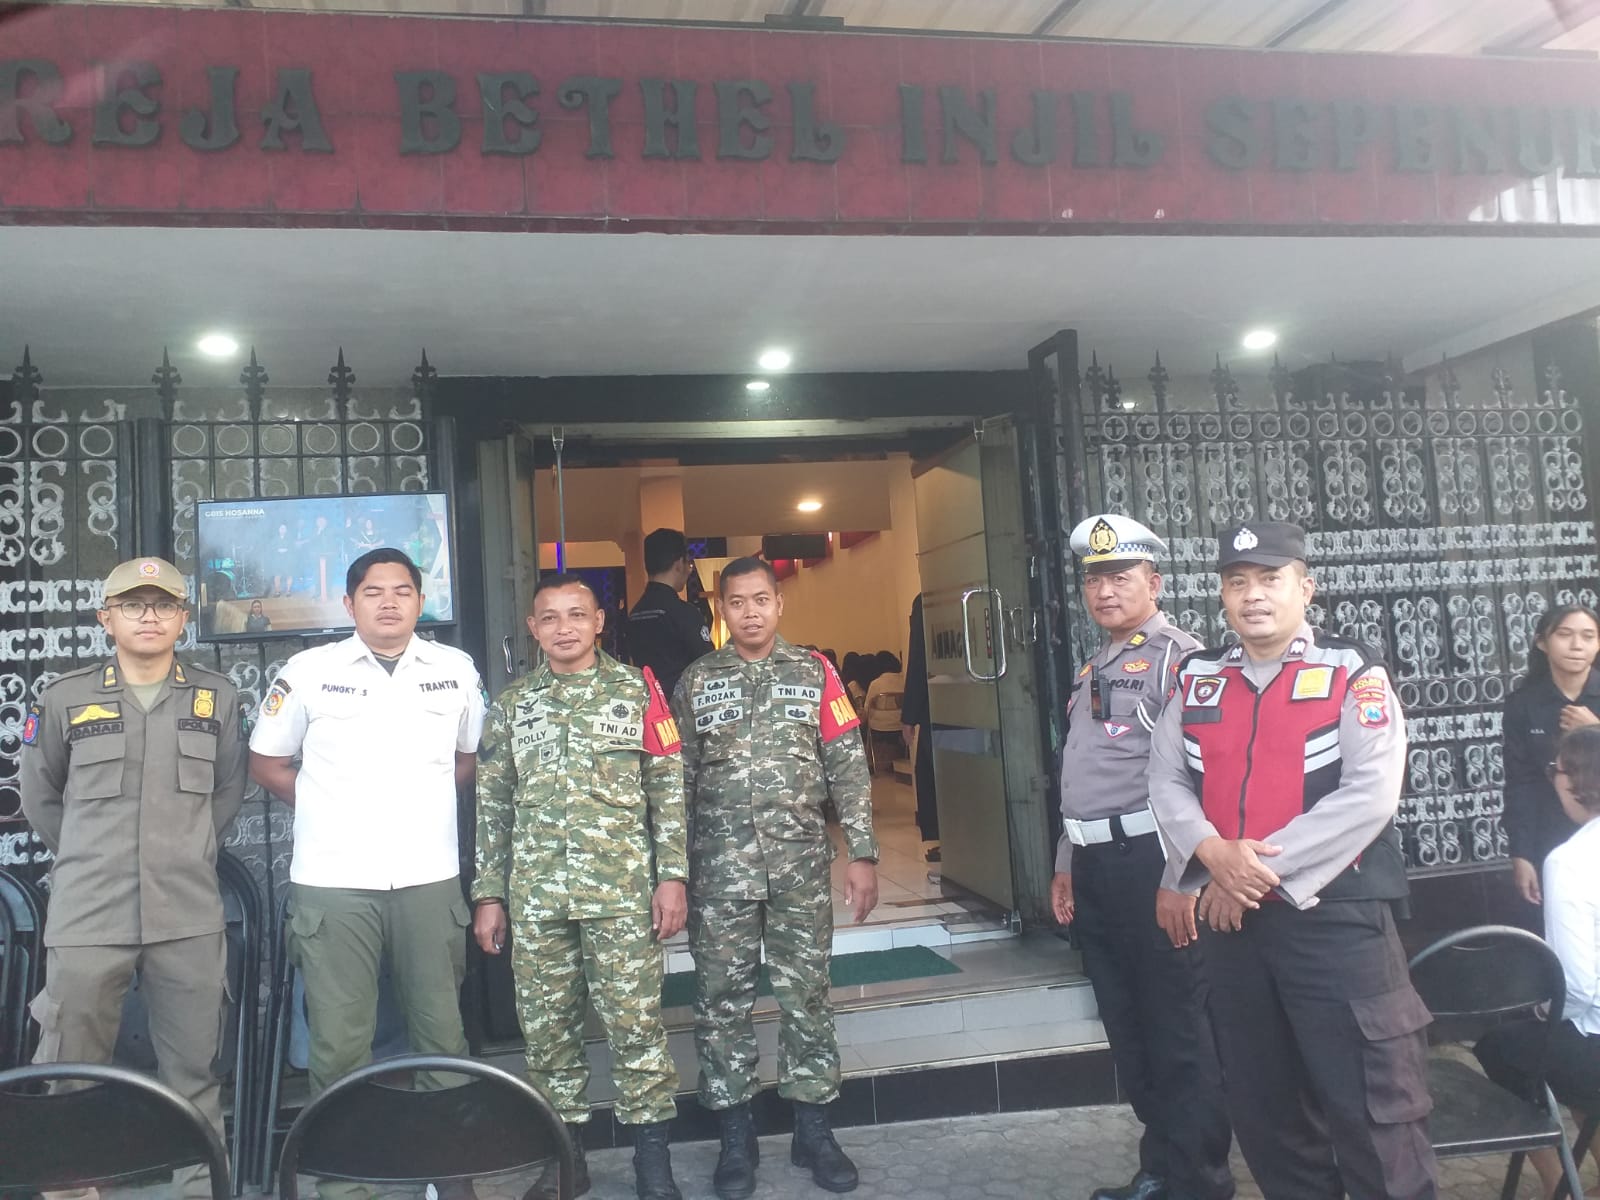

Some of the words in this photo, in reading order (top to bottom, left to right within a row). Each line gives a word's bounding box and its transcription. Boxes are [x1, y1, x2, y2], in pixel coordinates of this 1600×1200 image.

[392, 70, 846, 164] BETHEL
[899, 82, 1165, 168] INJIL
[225, 507, 265, 517] HOSANNA
[321, 683, 357, 695] PUNGKY
[419, 679, 459, 693] TRANTIB
[778, 687, 797, 697] TNI
[801, 689, 816, 699] AD
[697, 690, 736, 707] F.ROZAK
[600, 722, 619, 735] TNI
[621, 725, 637, 737] AD
[517, 729, 548, 747] POLLY
